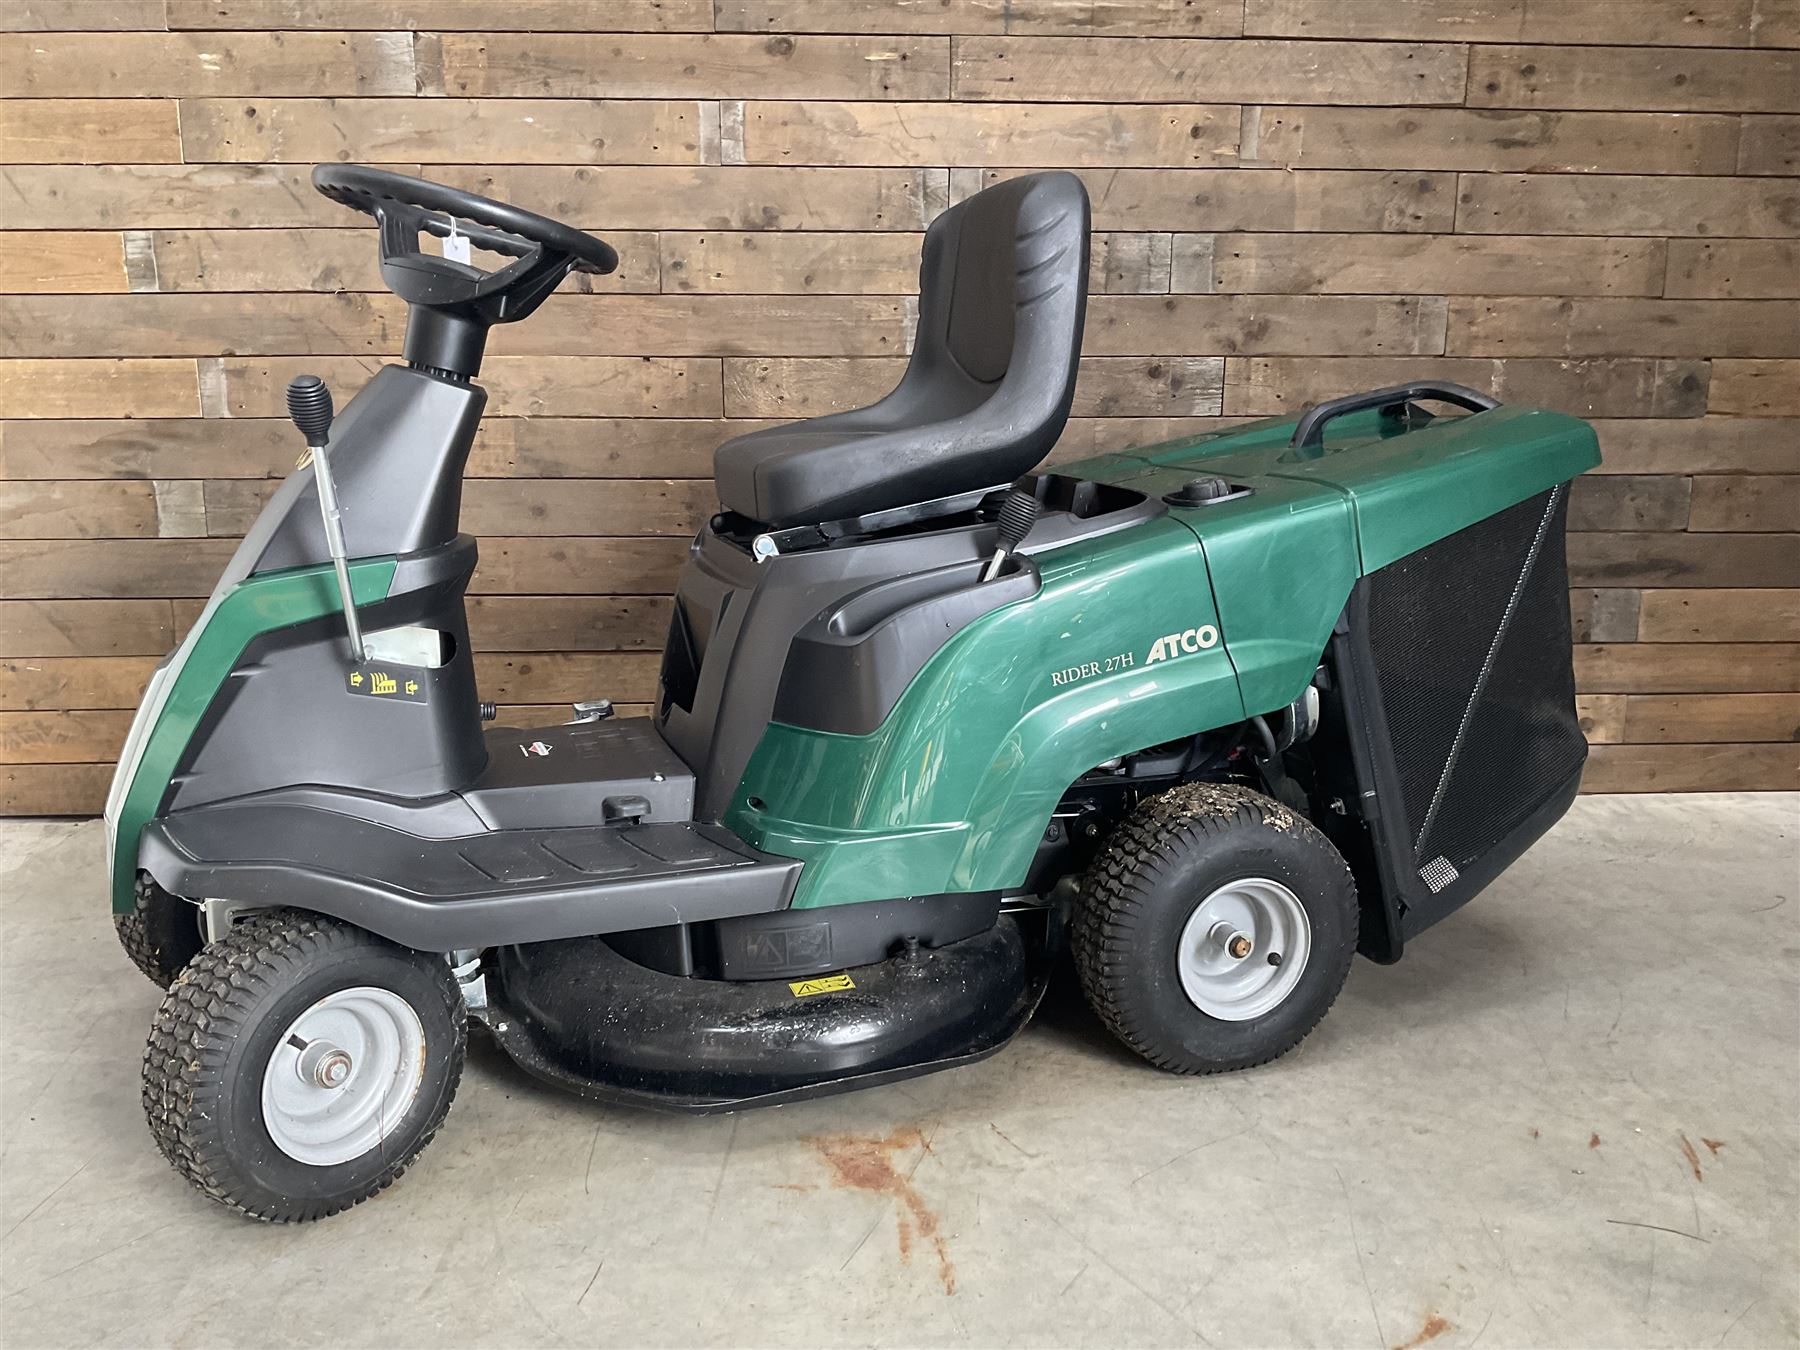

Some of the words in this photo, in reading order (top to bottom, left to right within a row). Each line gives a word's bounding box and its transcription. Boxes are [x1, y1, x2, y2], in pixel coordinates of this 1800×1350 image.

[1145, 624, 1218, 665] ATCO
[1051, 661, 1102, 686] RIDER
[1105, 652, 1135, 672] 27H
